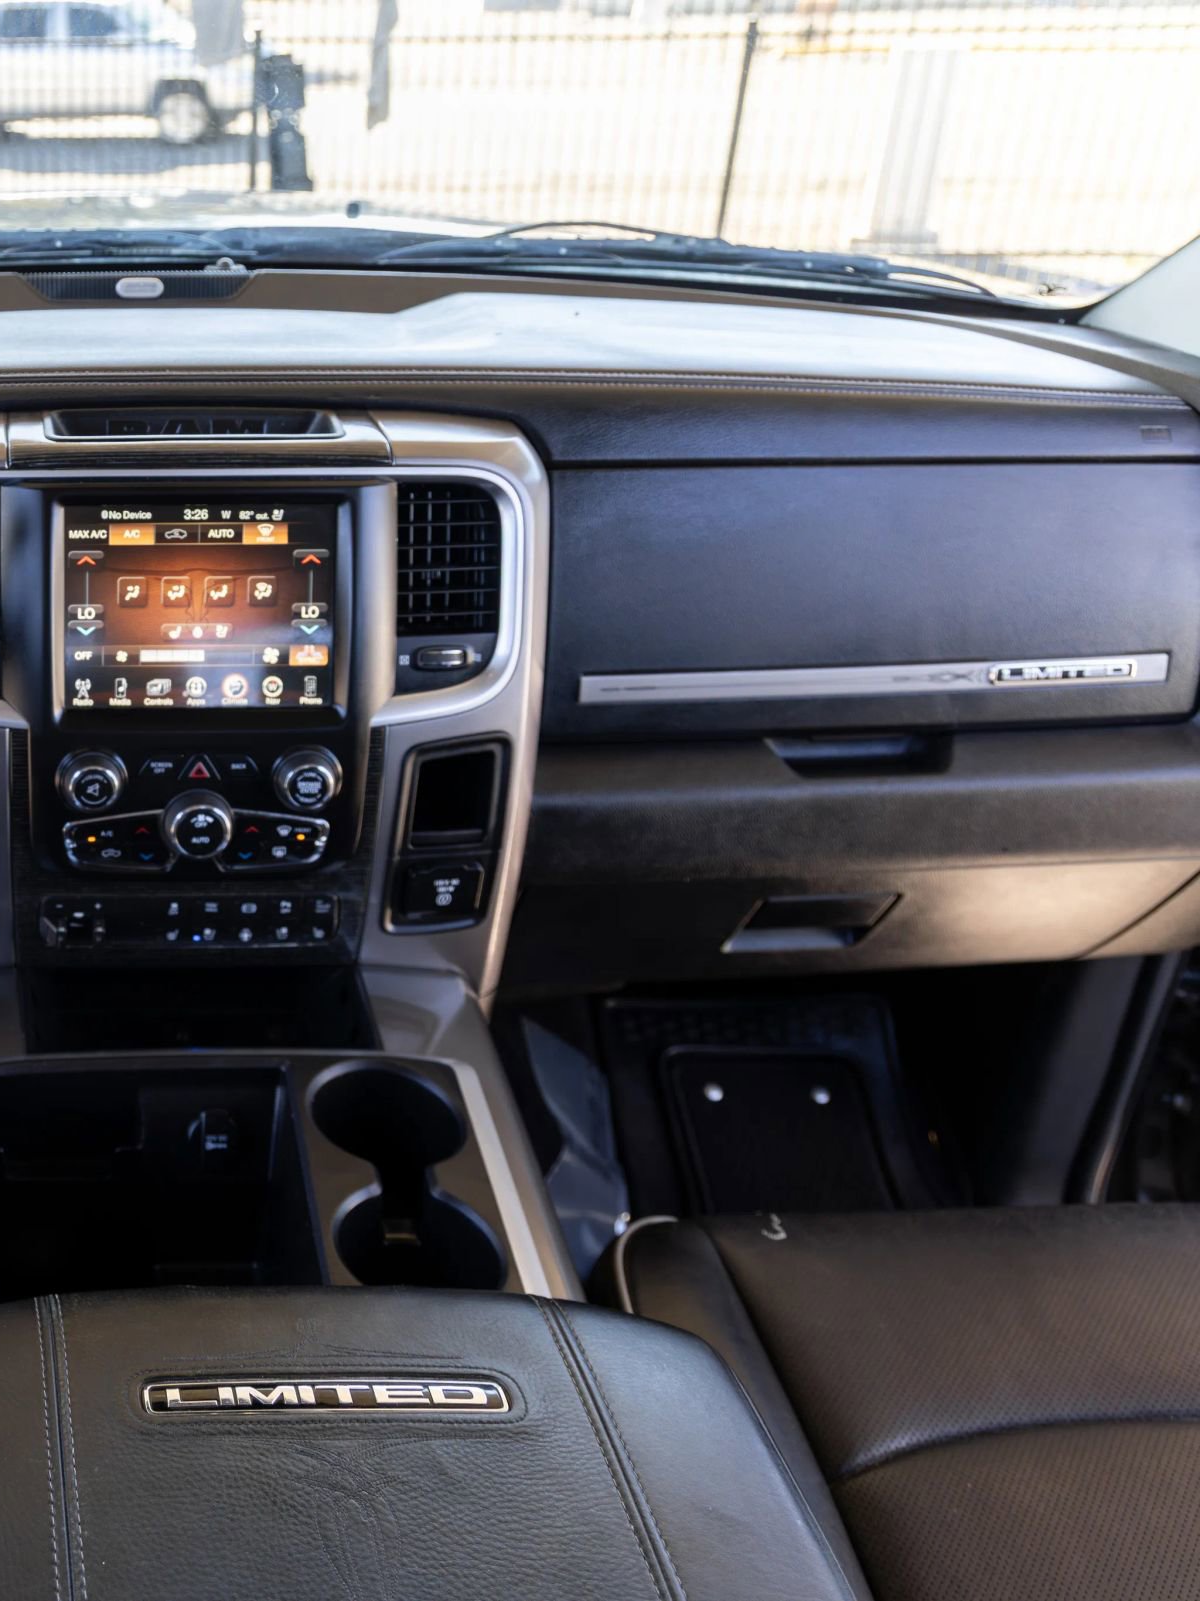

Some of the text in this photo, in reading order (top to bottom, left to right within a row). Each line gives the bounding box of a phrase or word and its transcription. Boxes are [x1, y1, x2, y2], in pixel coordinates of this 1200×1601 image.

[109, 510, 152, 520] No Device
[183, 509, 209, 520] 3:26
[221, 510, 231, 519] W
[68, 530, 107, 539] MAX A/C
[123, 529, 141, 539] A/C
[207, 529, 235, 538] AUTO
[77, 608, 96, 620] LO
[300, 607, 319, 619] LO
[74, 652, 92, 661] OFF
[73, 698, 94, 706] Radio
[109, 698, 132, 706] Media
[143, 698, 174, 706] Controls
[265, 697, 280, 705] Nav
[299, 696, 323, 705] Phone
[191, 836, 211, 844] AUTO
[166, 1385, 489, 1408] LIMITED
